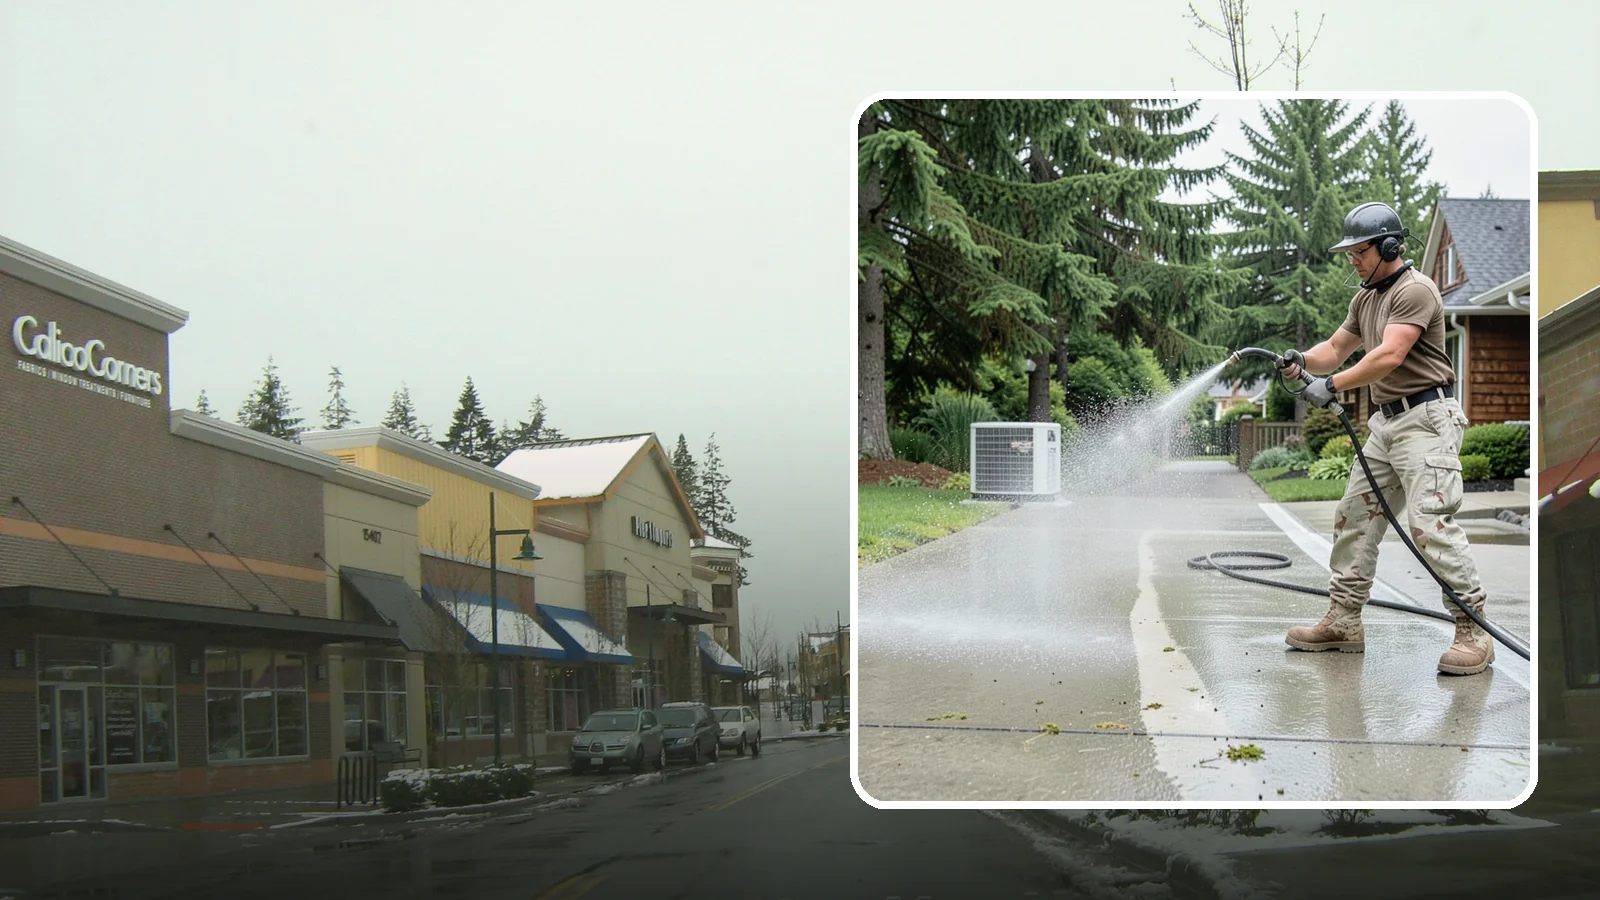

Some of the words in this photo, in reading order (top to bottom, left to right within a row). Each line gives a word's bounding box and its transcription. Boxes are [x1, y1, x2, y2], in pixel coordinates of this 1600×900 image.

[16, 360, 47, 377] FABRICS
[51, 370, 78, 386] WINDOW
[79, 378, 116, 398] TREATMENTS
